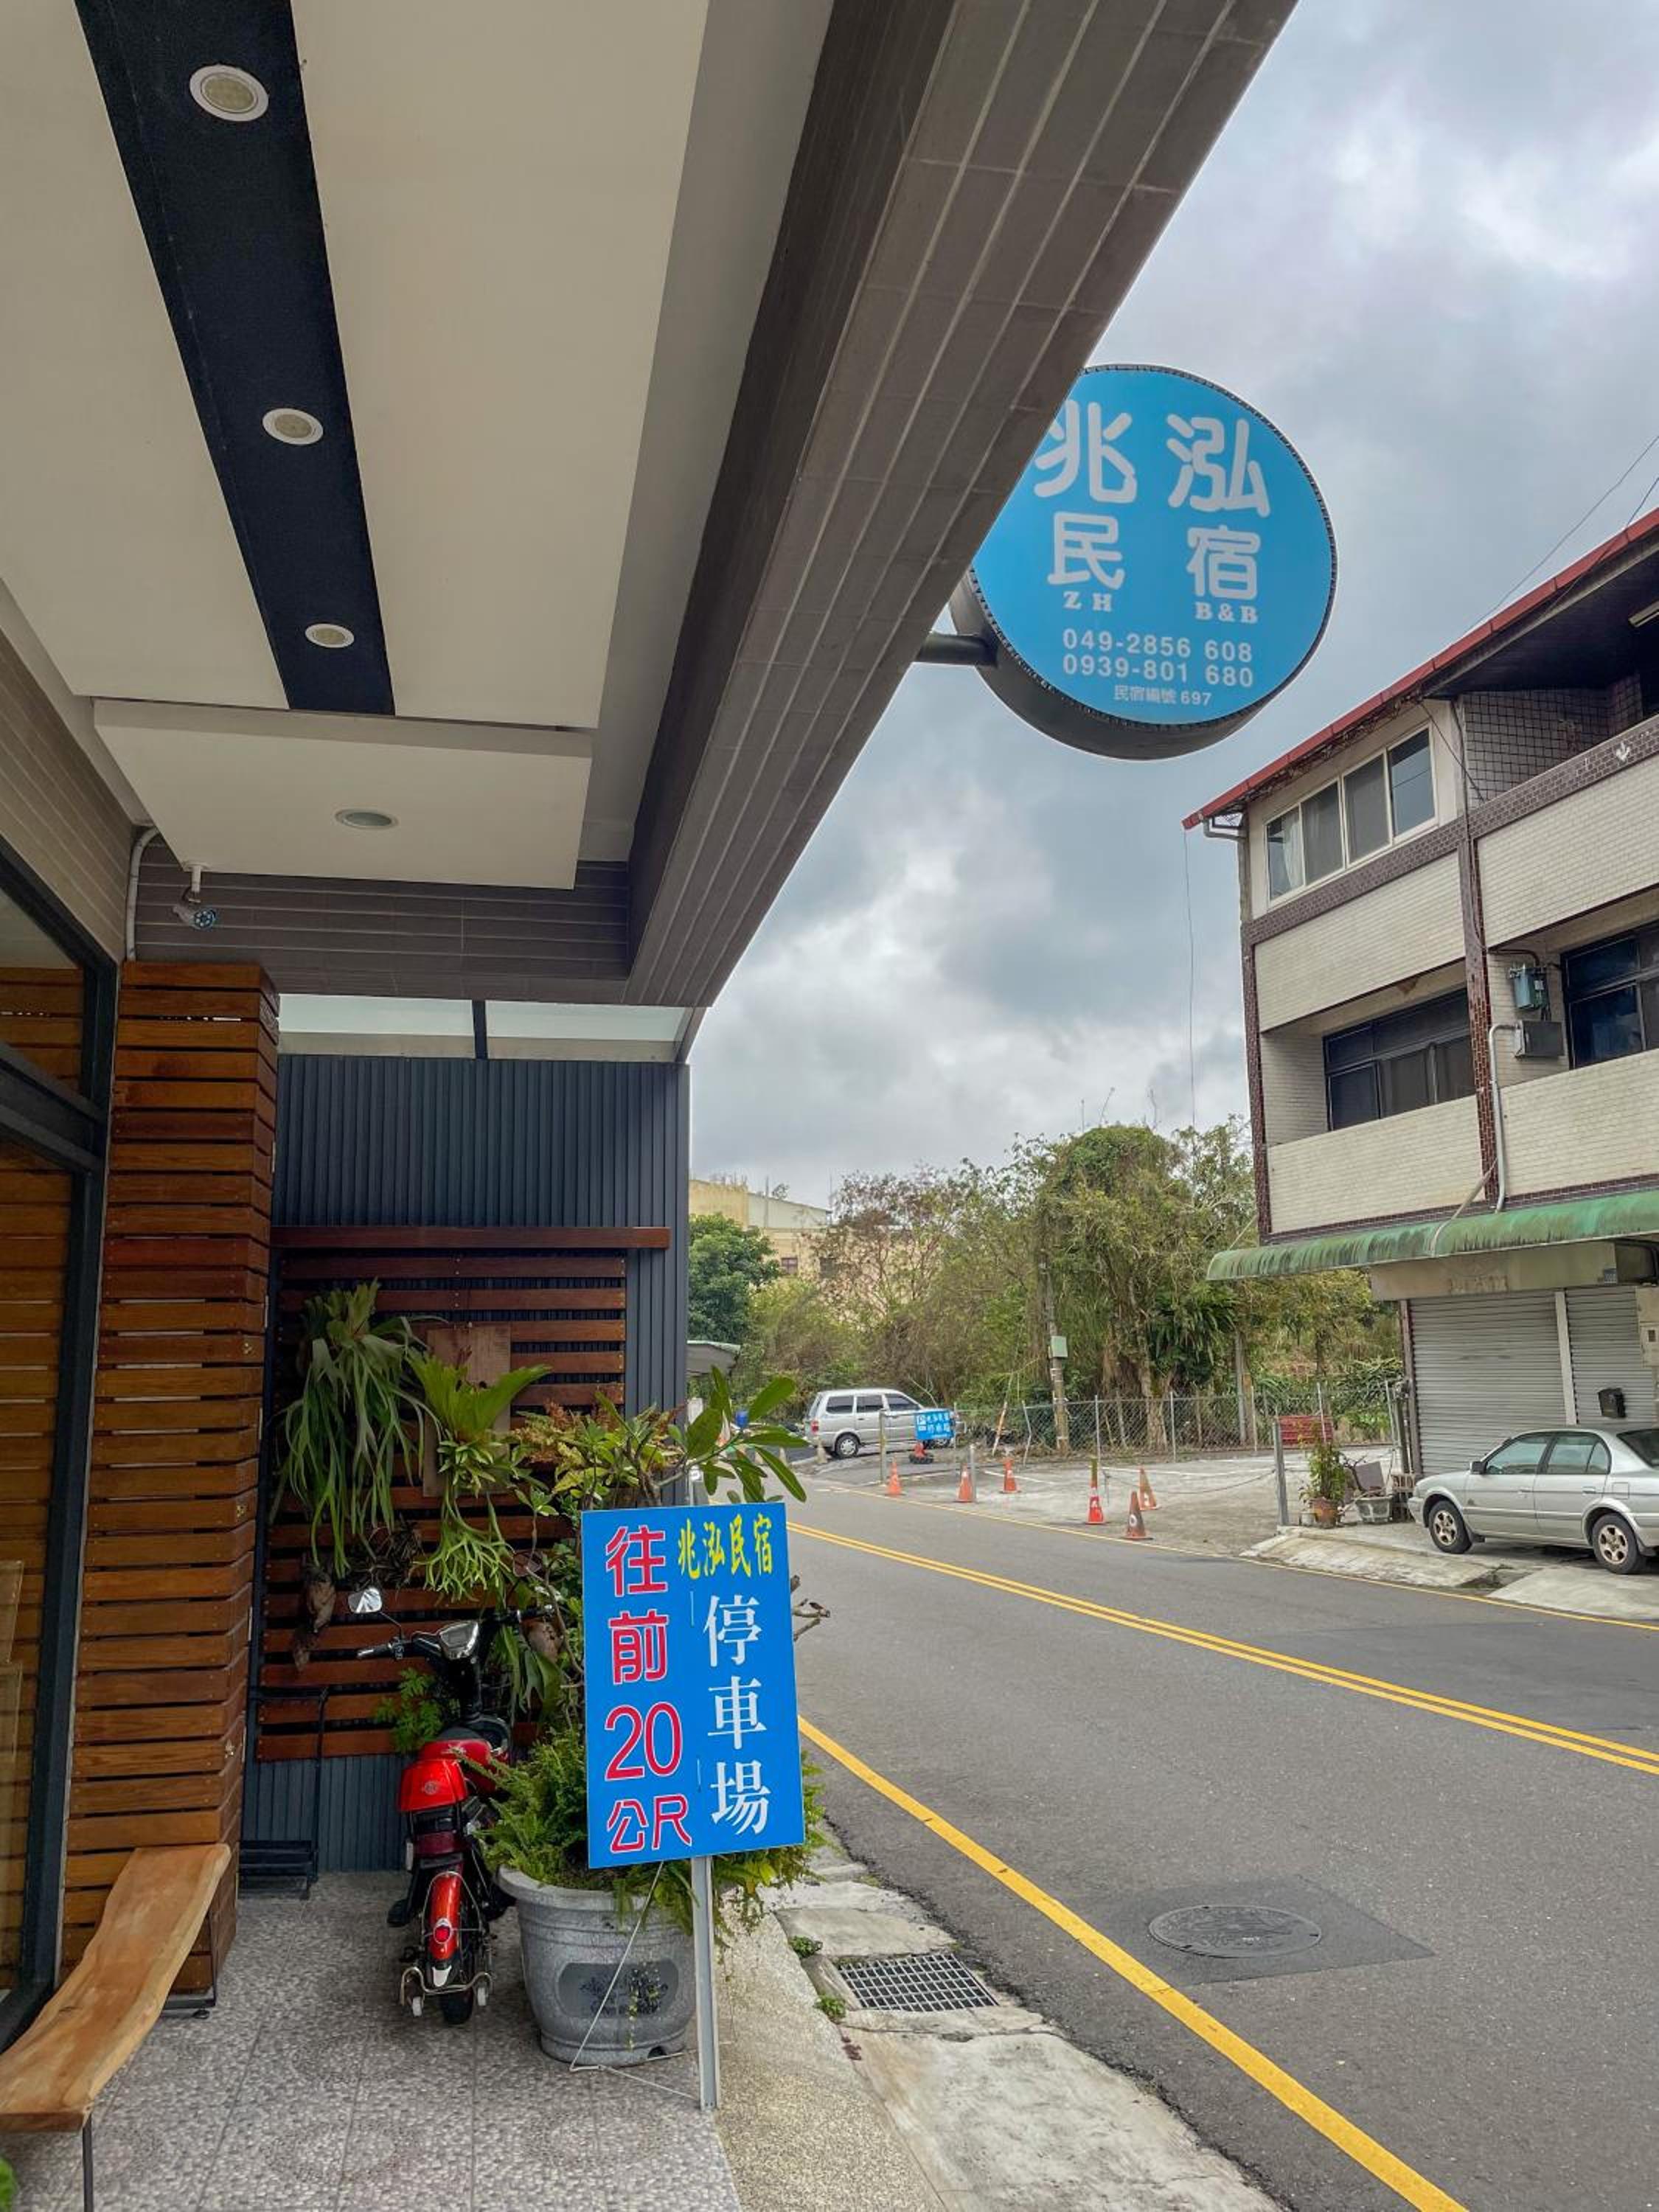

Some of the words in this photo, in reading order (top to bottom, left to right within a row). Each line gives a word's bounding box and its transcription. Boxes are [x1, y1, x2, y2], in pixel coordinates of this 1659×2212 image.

[1034, 399, 1270, 518] 兆泓
[1047, 511, 1262, 600] 民宿
[1062, 628, 1191, 658] 049-2856
[1204, 640, 1252, 663] 608
[1062, 654, 1190, 683] 0939-801
[1205, 664, 1253, 688] 680
[1180, 690, 1211, 706] 697
[678, 1512, 774, 1581] 兆泓民宿
[703, 1595, 771, 1835] 停車場
